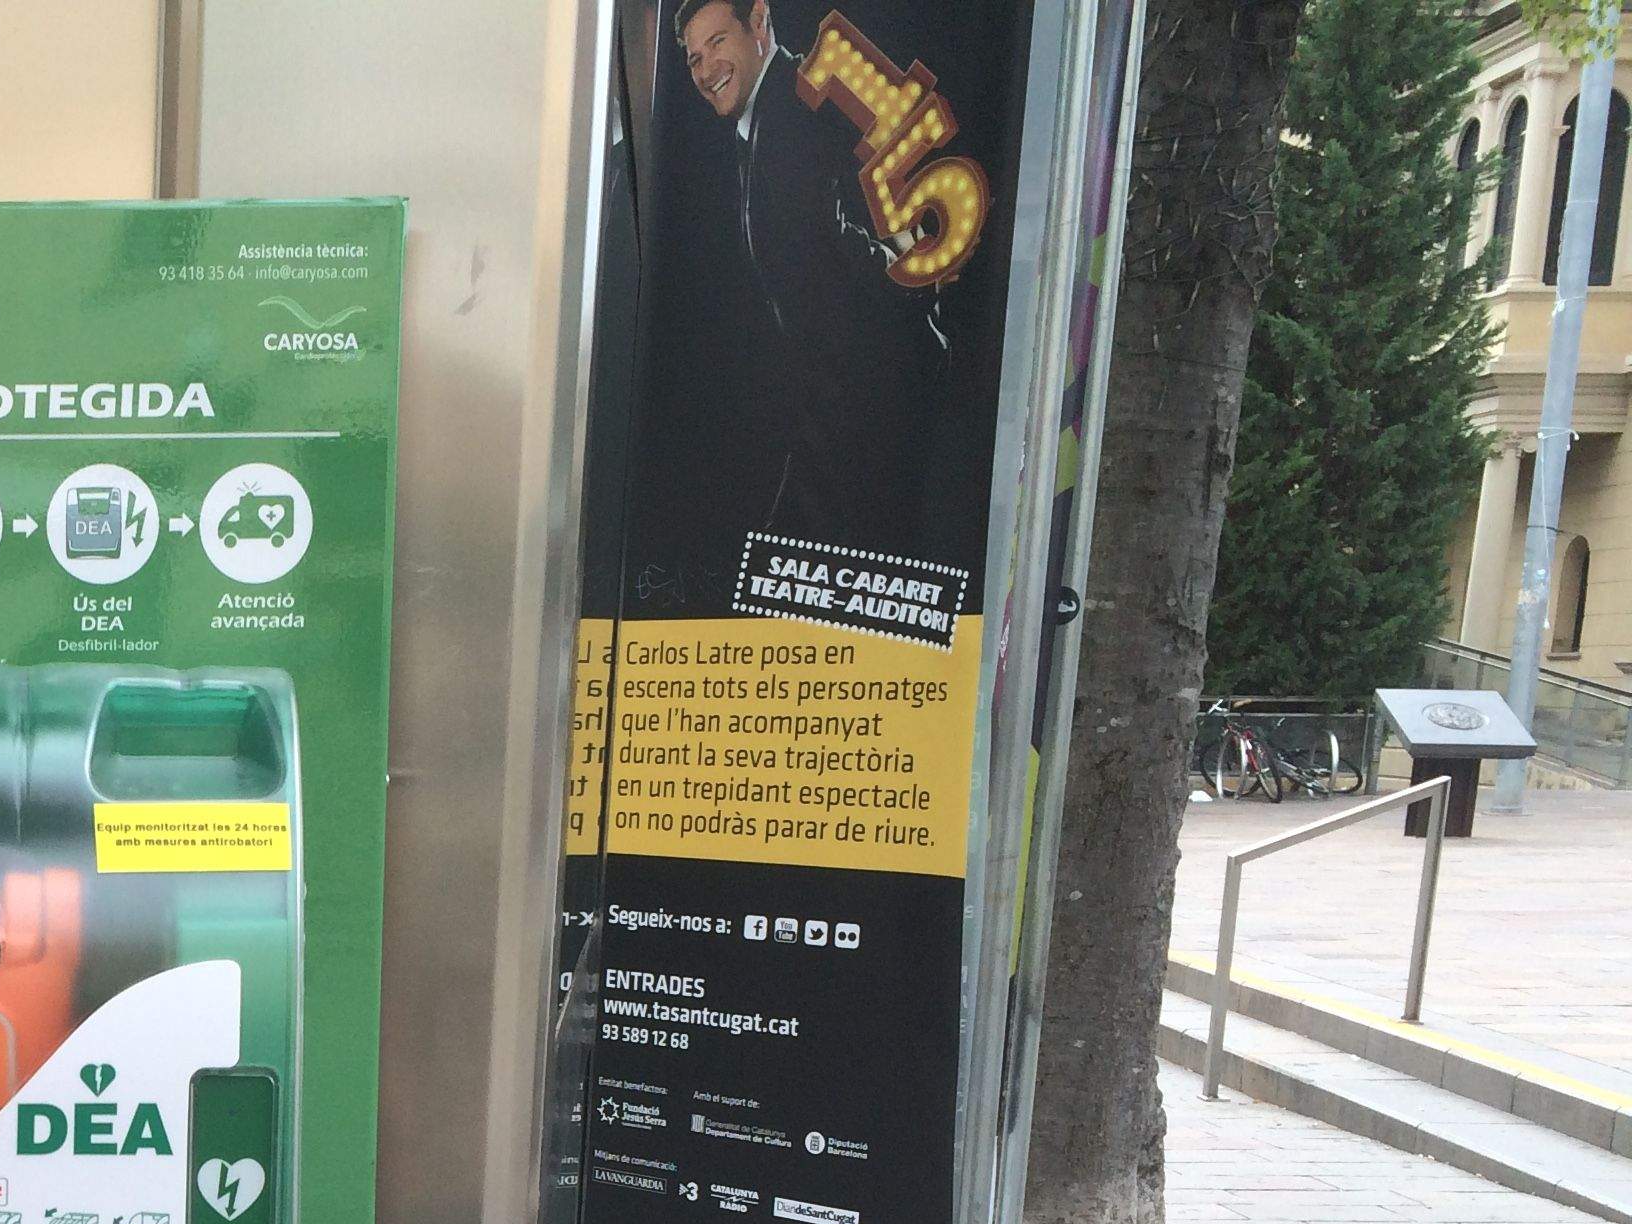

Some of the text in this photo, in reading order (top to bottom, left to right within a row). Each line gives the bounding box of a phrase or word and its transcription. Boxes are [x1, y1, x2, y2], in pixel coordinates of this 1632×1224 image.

[797, 9, 992, 288] 15
[238, 243, 369, 260] Assistència tècnica:
[159, 264, 369, 284] 93 418 35 64 info@caryosa.com
[263, 332, 359, 351] CARYOSA
[74, 520, 113, 536] DEA
[768, 555, 944, 608] SALA CABARET
[73, 592, 133, 613] Ús del
[217, 592, 295, 610] Atenció
[749, 575, 950, 633] TEATRE-AUDITORI
[80, 614, 125, 633] DEA
[210, 612, 306, 633] avançada
[625, 640, 855, 671] Carlos Latre posa en
[623, 673, 948, 709] escena tots els personatges
[621, 711, 660, 738] que
[727, 711, 884, 742] acompanyat
[619, 740, 915, 776] durant la seva trajectòria
[617, 773, 931, 812] en un trepidant espectacle
[97, 822, 287, 833] Equip monitoritzat les 24 hores
[615, 809, 935, 847] on no podràs parar de riure.
[115, 836, 273, 847] amb mesures antirobatori
[608, 904, 711, 936] Segueix-nos
[715, 918, 732, 935] a:
[605, 968, 706, 999] ENTRADES
[603, 998, 799, 1038] www.tasantcugat.cat
[602, 1023, 689, 1050] 93 589 12 68
[622, 1102, 660, 1116] Fundació
[693, 1090, 712, 1102] Amb
[712, 1094, 720, 1103] el
[721, 1096, 746, 1109] suport
[16, 1102, 174, 1157] DEA
[621, 1111, 644, 1123] Jesús
[645, 1115, 667, 1127] Serra
[705, 1127, 751, 1142] Departament
[828, 1137, 868, 1151] Diputació
[827, 1146, 868, 1160] Barcelona
[710, 1184, 759, 1200] CATALUNYA
